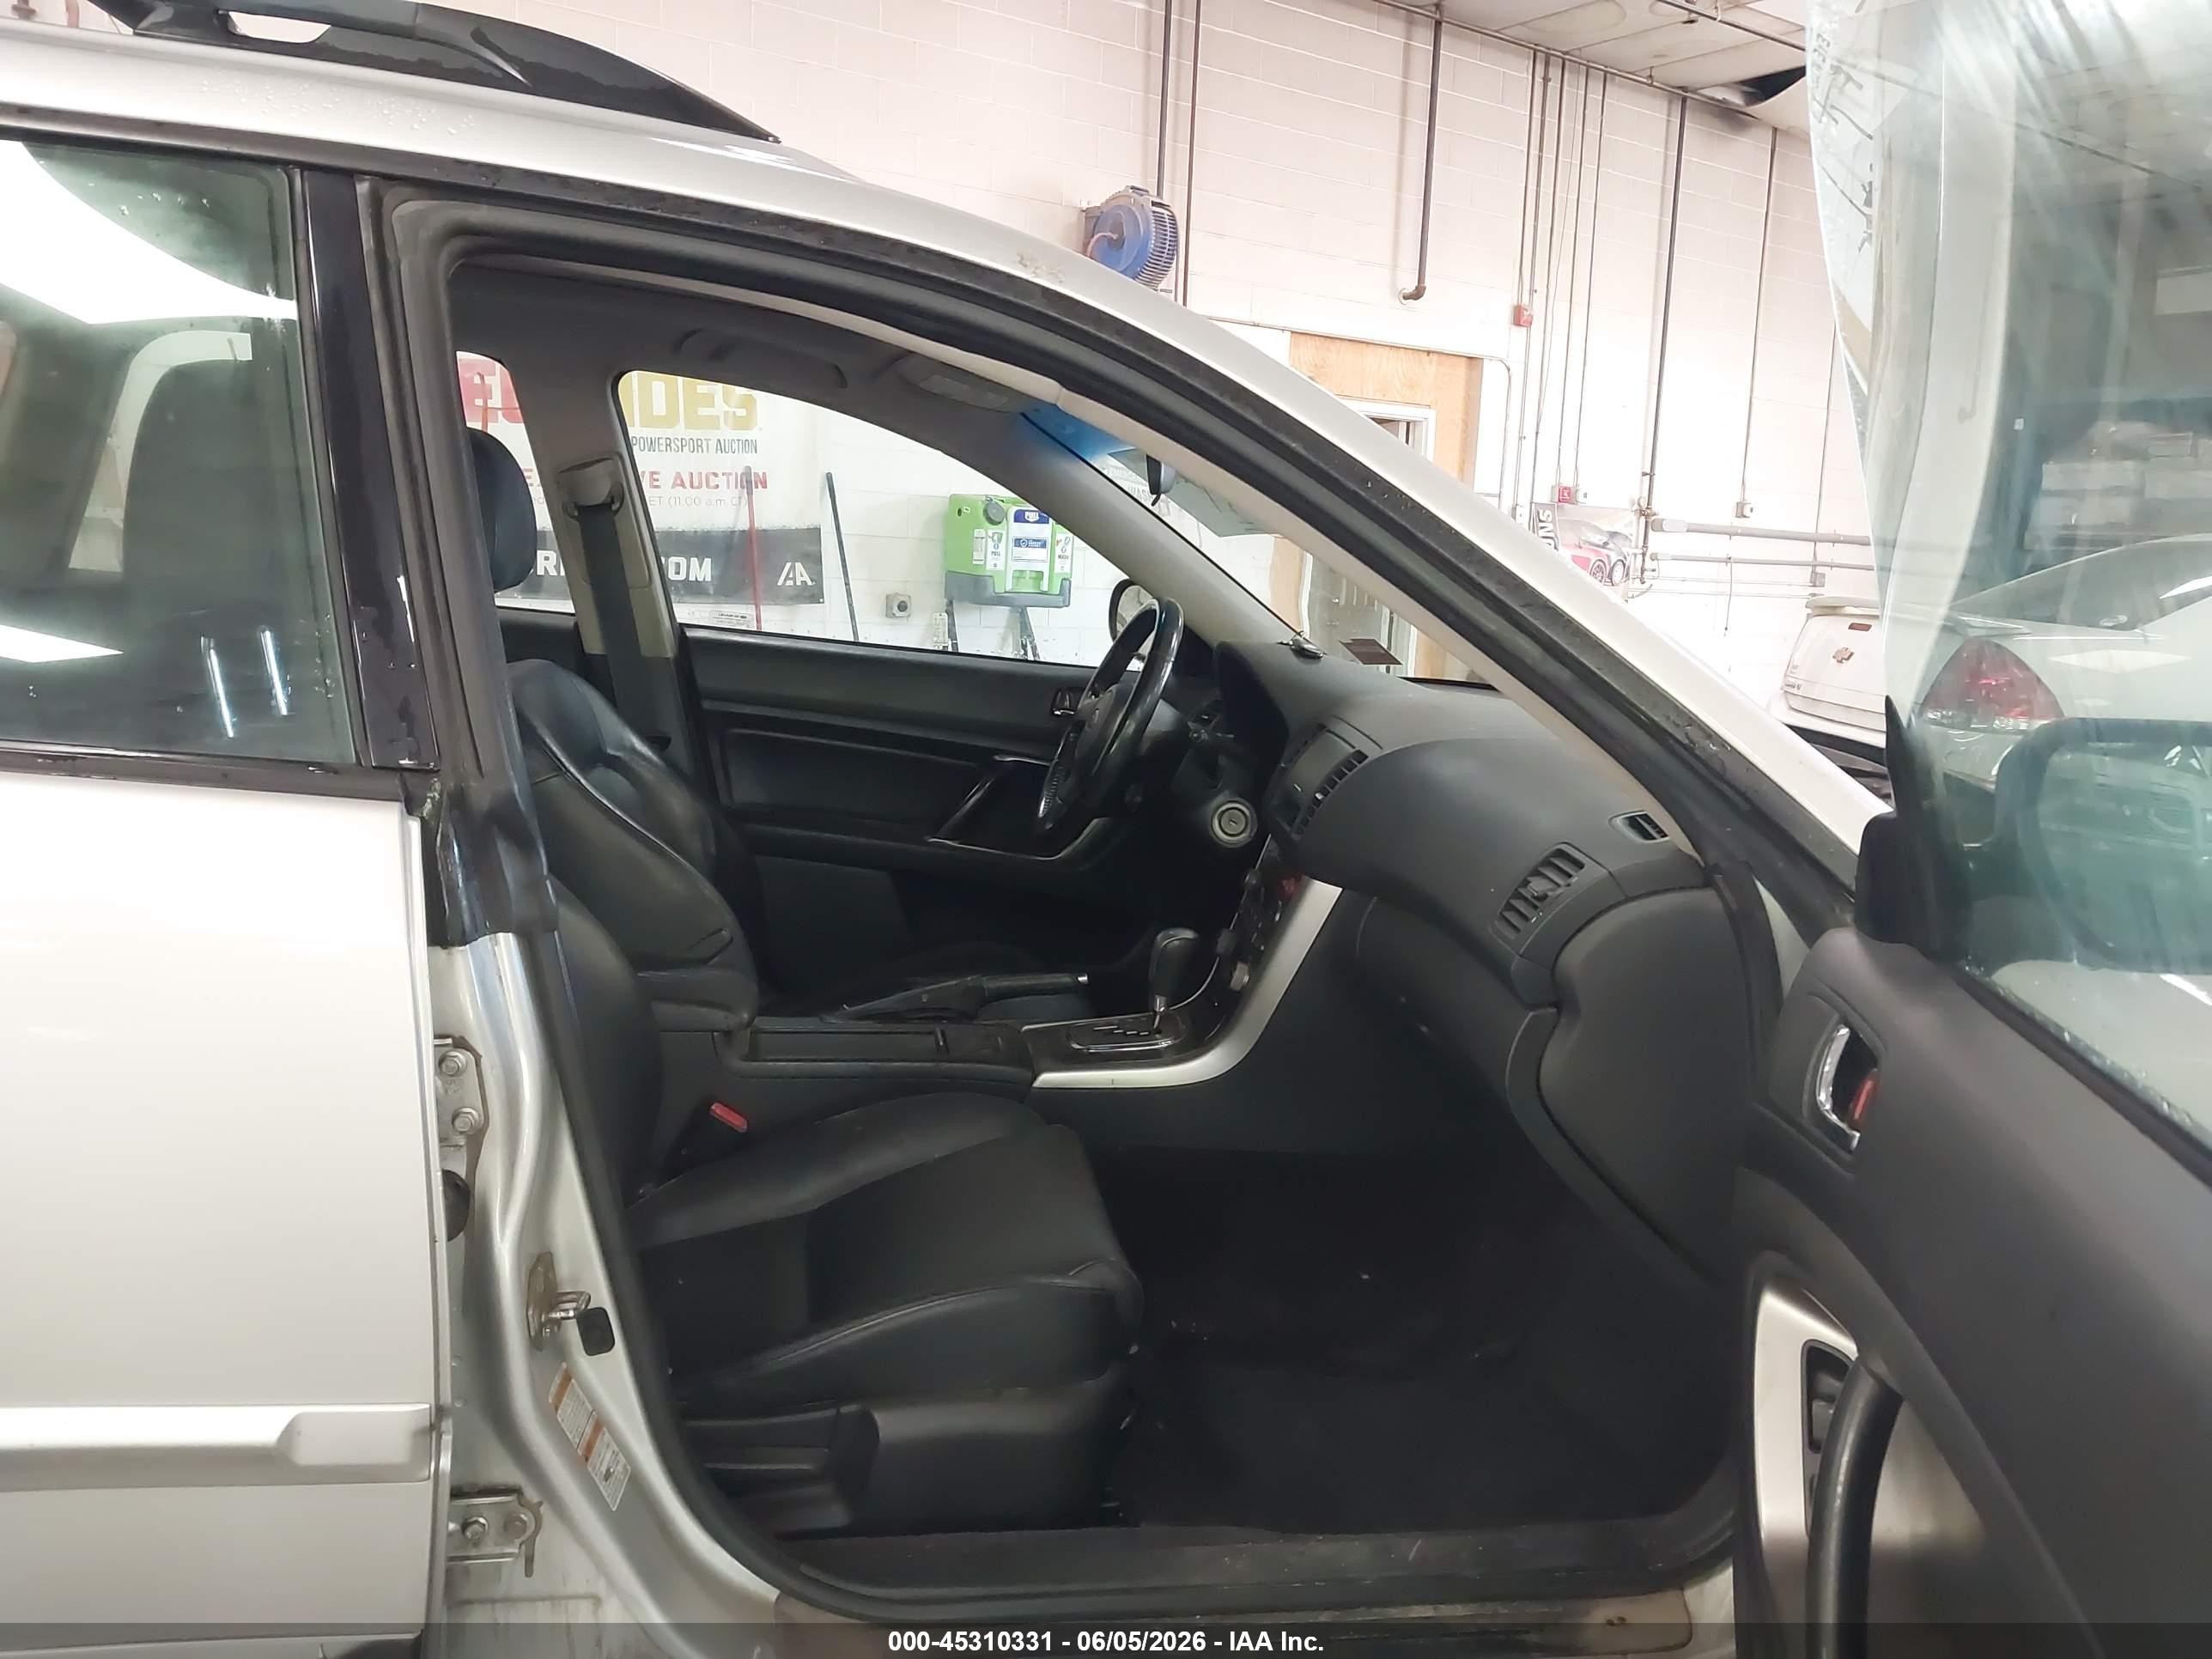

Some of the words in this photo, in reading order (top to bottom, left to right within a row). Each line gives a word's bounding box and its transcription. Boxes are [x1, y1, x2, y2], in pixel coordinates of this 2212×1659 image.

[631, 436, 711, 453] POWERSPORT
[715, 439, 757, 454] AUCTION
[671, 471, 768, 489] AUCTION
